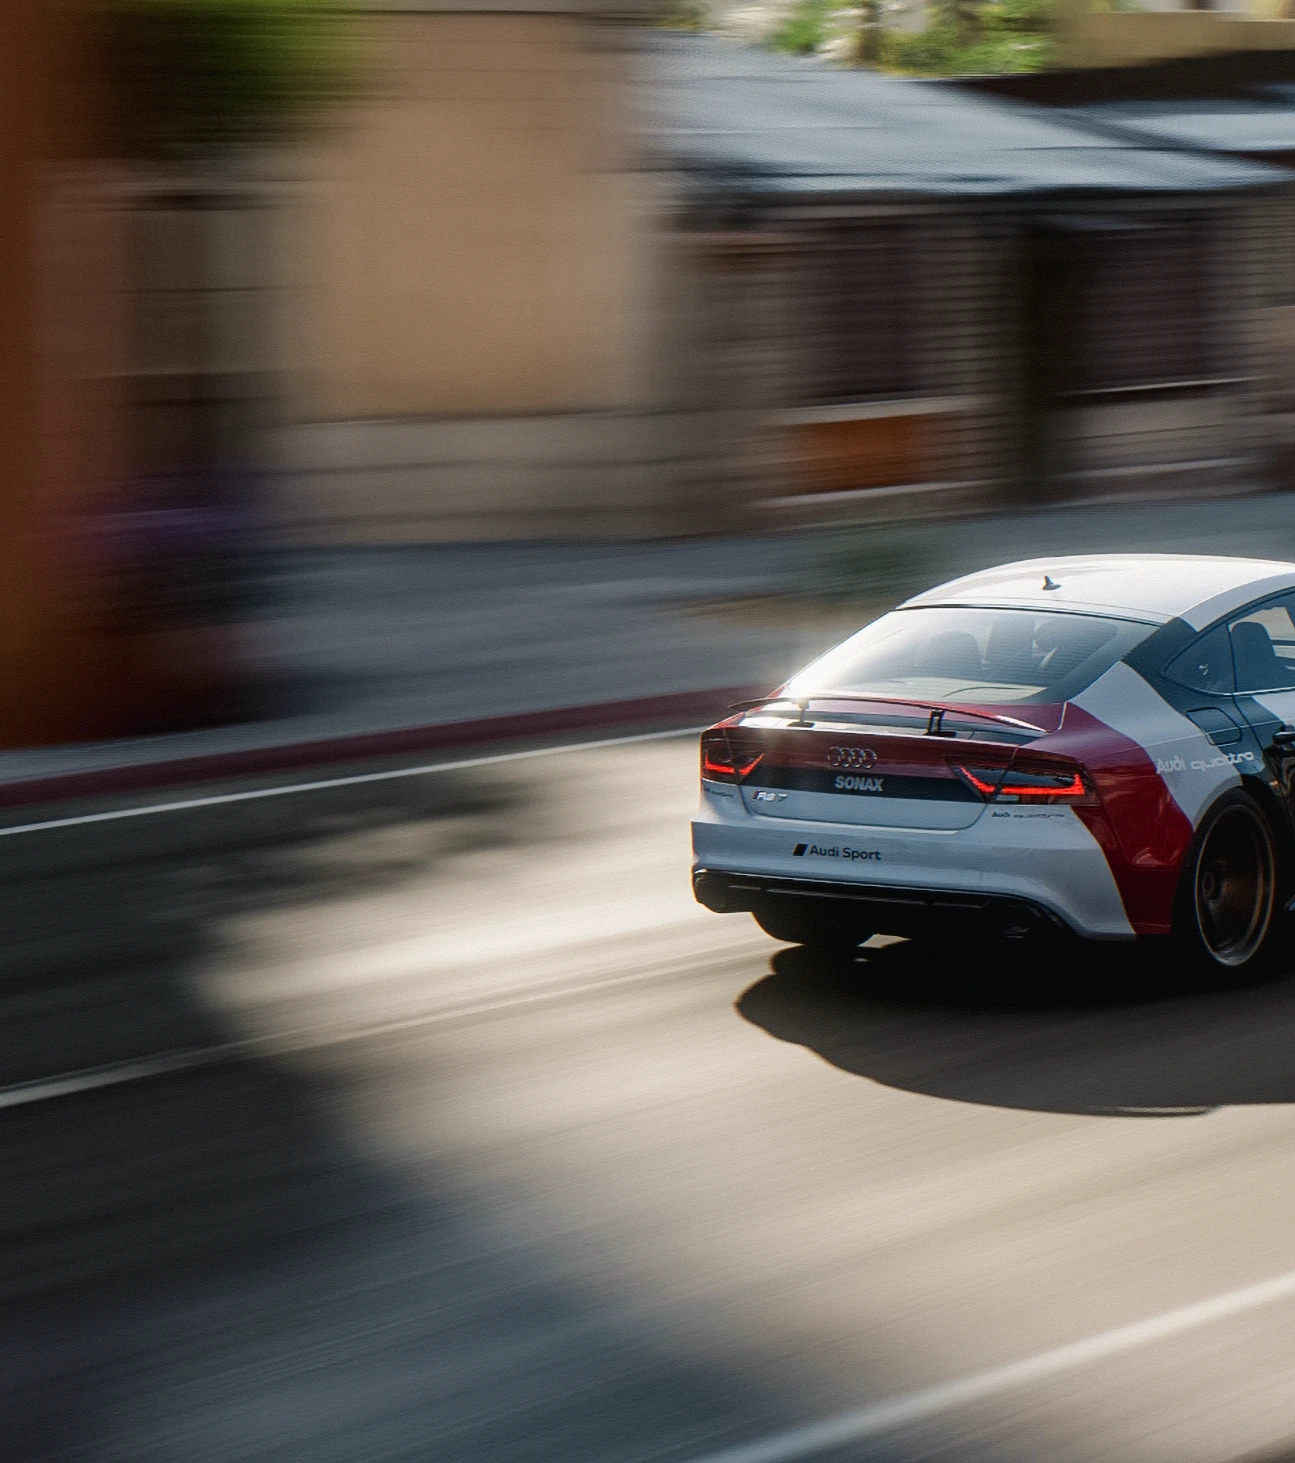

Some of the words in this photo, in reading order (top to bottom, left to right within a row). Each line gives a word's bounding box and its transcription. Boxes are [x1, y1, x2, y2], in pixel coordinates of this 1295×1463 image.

[1156, 755, 1187, 774] Audi
[1191, 751, 1255, 772] quattro
[835, 776, 884, 791] SONAX
[809, 845, 839, 857] Audi
[842, 848, 882, 861] Sport
